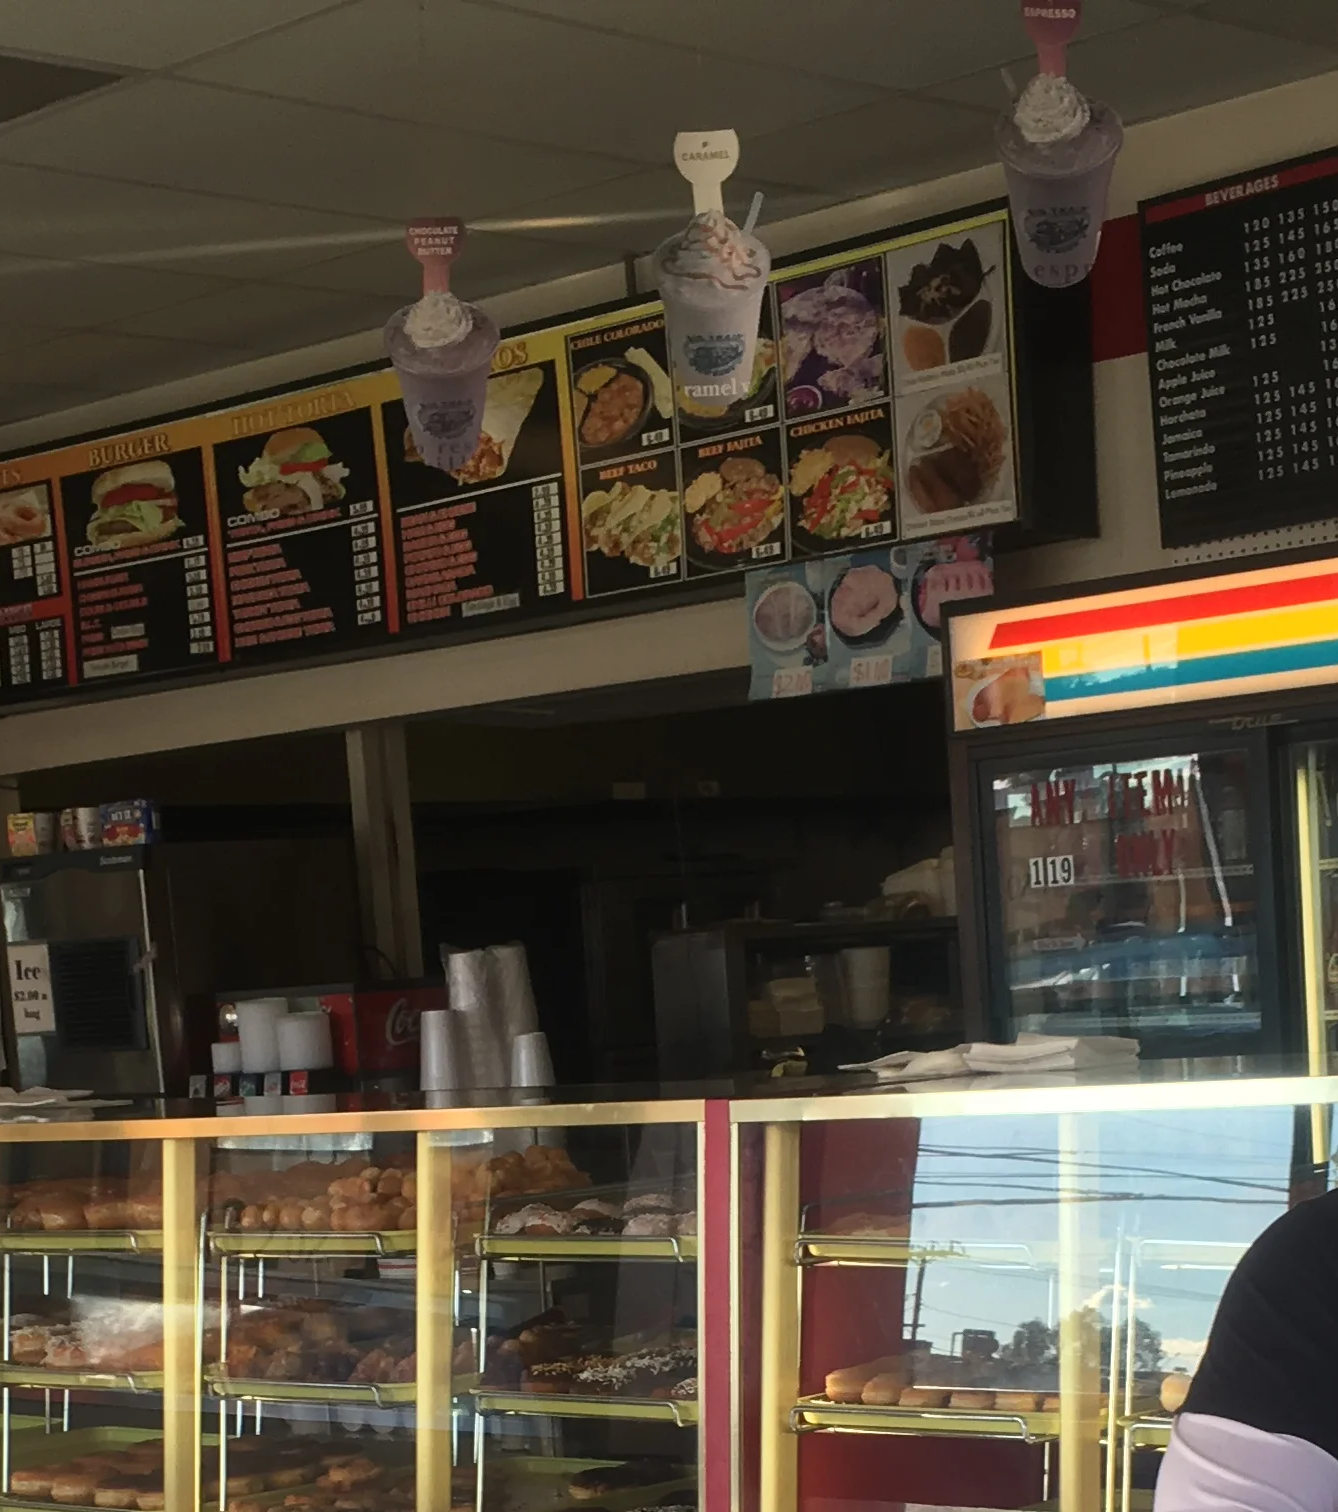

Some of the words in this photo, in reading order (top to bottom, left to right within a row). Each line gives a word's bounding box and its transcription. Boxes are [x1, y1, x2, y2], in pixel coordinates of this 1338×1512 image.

[1023, 6, 1076, 19] ESPRESSO
[681, 149, 730, 161] CARAMEL
[1204, 174, 1279, 207] BEVERAGES
[1244, 216, 1270, 234] 120
[1278, 207, 1305, 225] 135
[414, 236, 454, 246] PEANUT
[1150, 262, 1176, 278] Soda
[1244, 236, 1270, 254] 125
[1279, 227, 1305, 244] 145
[1151, 284, 1169, 297] Hot
[1244, 256, 1270, 273] 135
[1278, 247, 1306, 265] 160
[1152, 302, 1170, 315] Hot
[1245, 275, 1271, 292] 185
[1278, 267, 1306, 284] 225
[1247, 295, 1273, 311] 185
[1281, 285, 1309, 303] 225
[1248, 313, 1274, 330] 125
[1251, 333, 1277, 349] 125
[1252, 371, 1279, 388] 125
[1254, 389, 1281, 405] 125
[1289, 381, 1316, 397] 145
[789, 418, 845, 438] CHICKEN
[847, 408, 884, 426] FAJITA
[1256, 407, 1282, 425] 125
[1290, 401, 1317, 417] 145
[1255, 427, 1282, 443] 125
[1290, 420, 1318, 436] 145
[88, 433, 171, 468] BURGER
[698, 446, 723, 459] BEEF
[726, 436, 763, 452] FAJITA
[1257, 445, 1284, 461] 125
[1292, 439, 1319, 455] 145
[599, 466, 625, 480] BEEF
[628, 460, 658, 474] TACO
[1258, 464, 1284, 481] 125
[1293, 457, 1319, 474] 145
[227, 508, 280, 528] COMBO
[15, 960, 41, 981] Ice
[24, 1008, 40, 1020] bag
